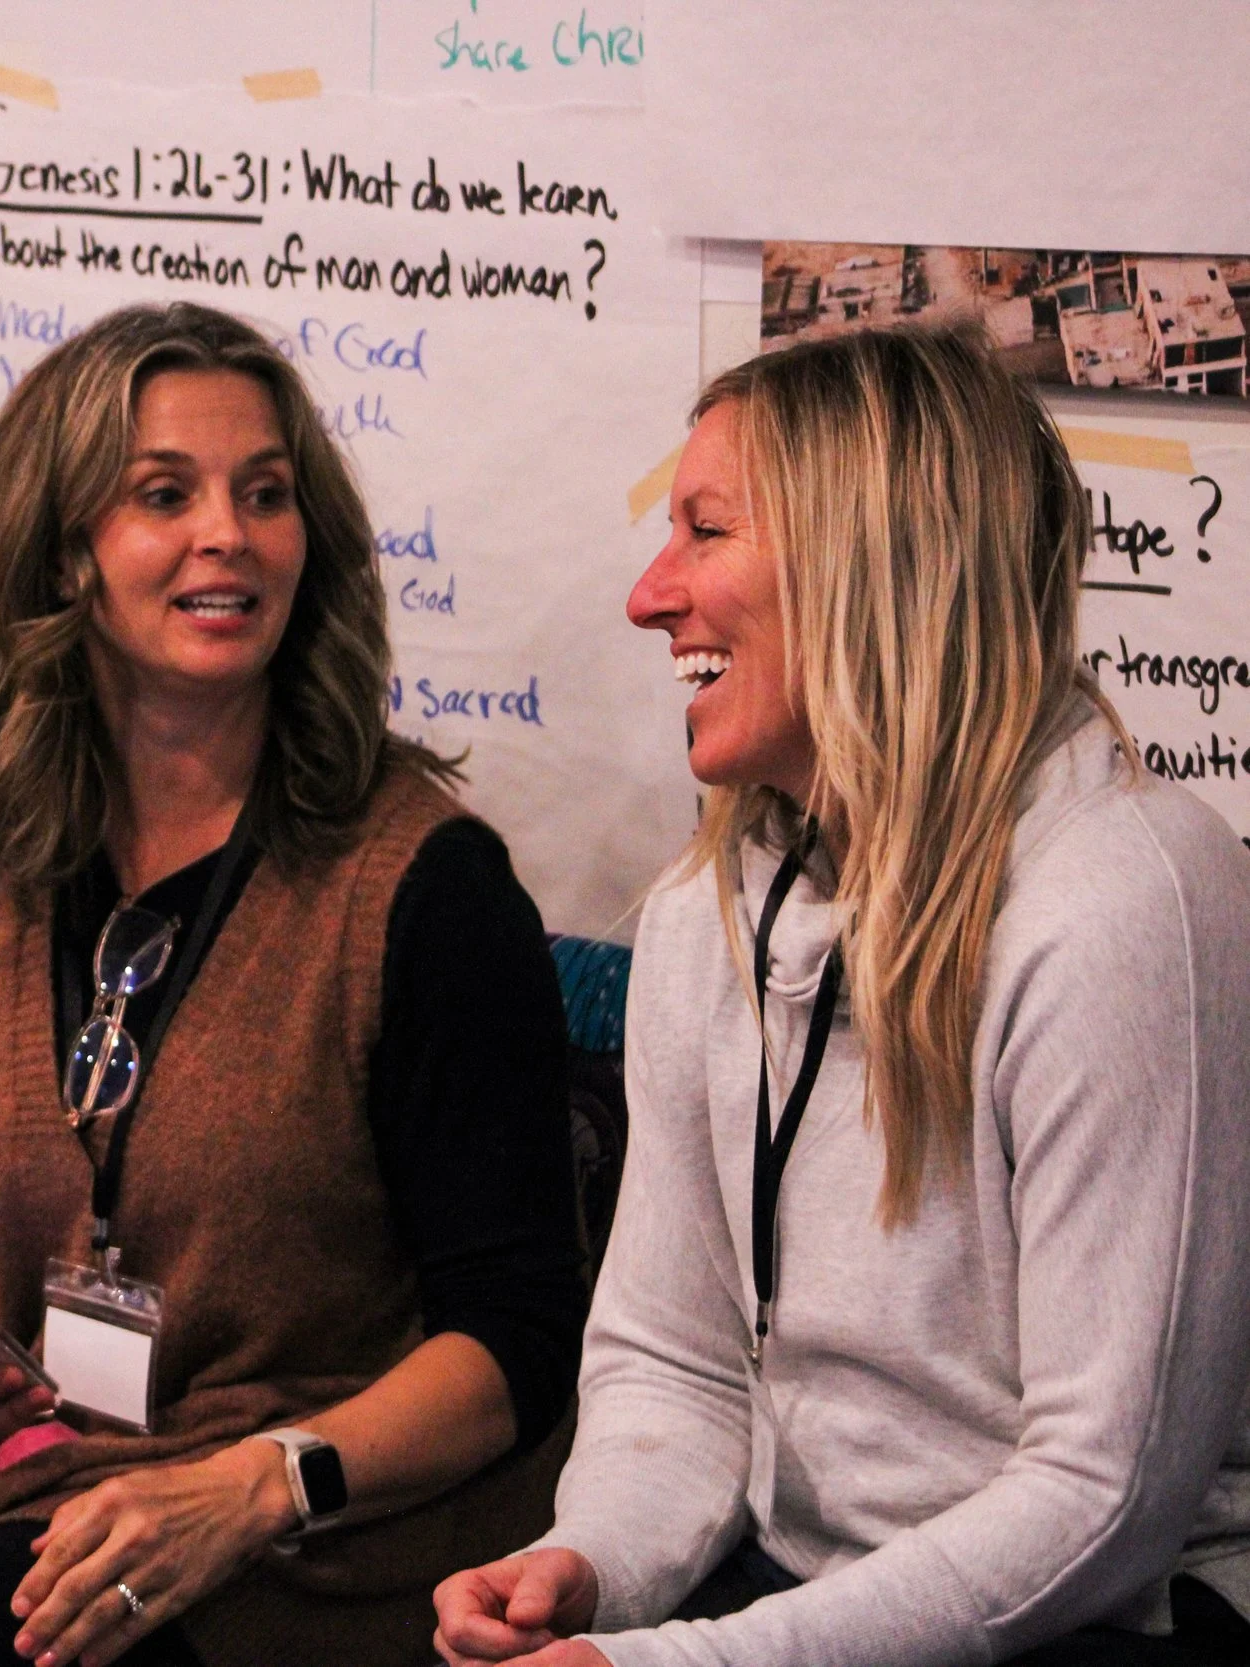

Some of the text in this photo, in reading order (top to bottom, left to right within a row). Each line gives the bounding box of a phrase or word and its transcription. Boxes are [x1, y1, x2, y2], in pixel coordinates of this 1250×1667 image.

[301, 148, 401, 209] What
[411, 157, 450, 213] do
[460, 179, 505, 215] we
[77, 228, 122, 274] the
[130, 240, 250, 288] creation
[263, 231, 308, 290] of
[316, 256, 382, 291] man
[390, 248, 452, 300] and
[400, 572, 456, 617] God
[415, 673, 545, 728] Sacred
